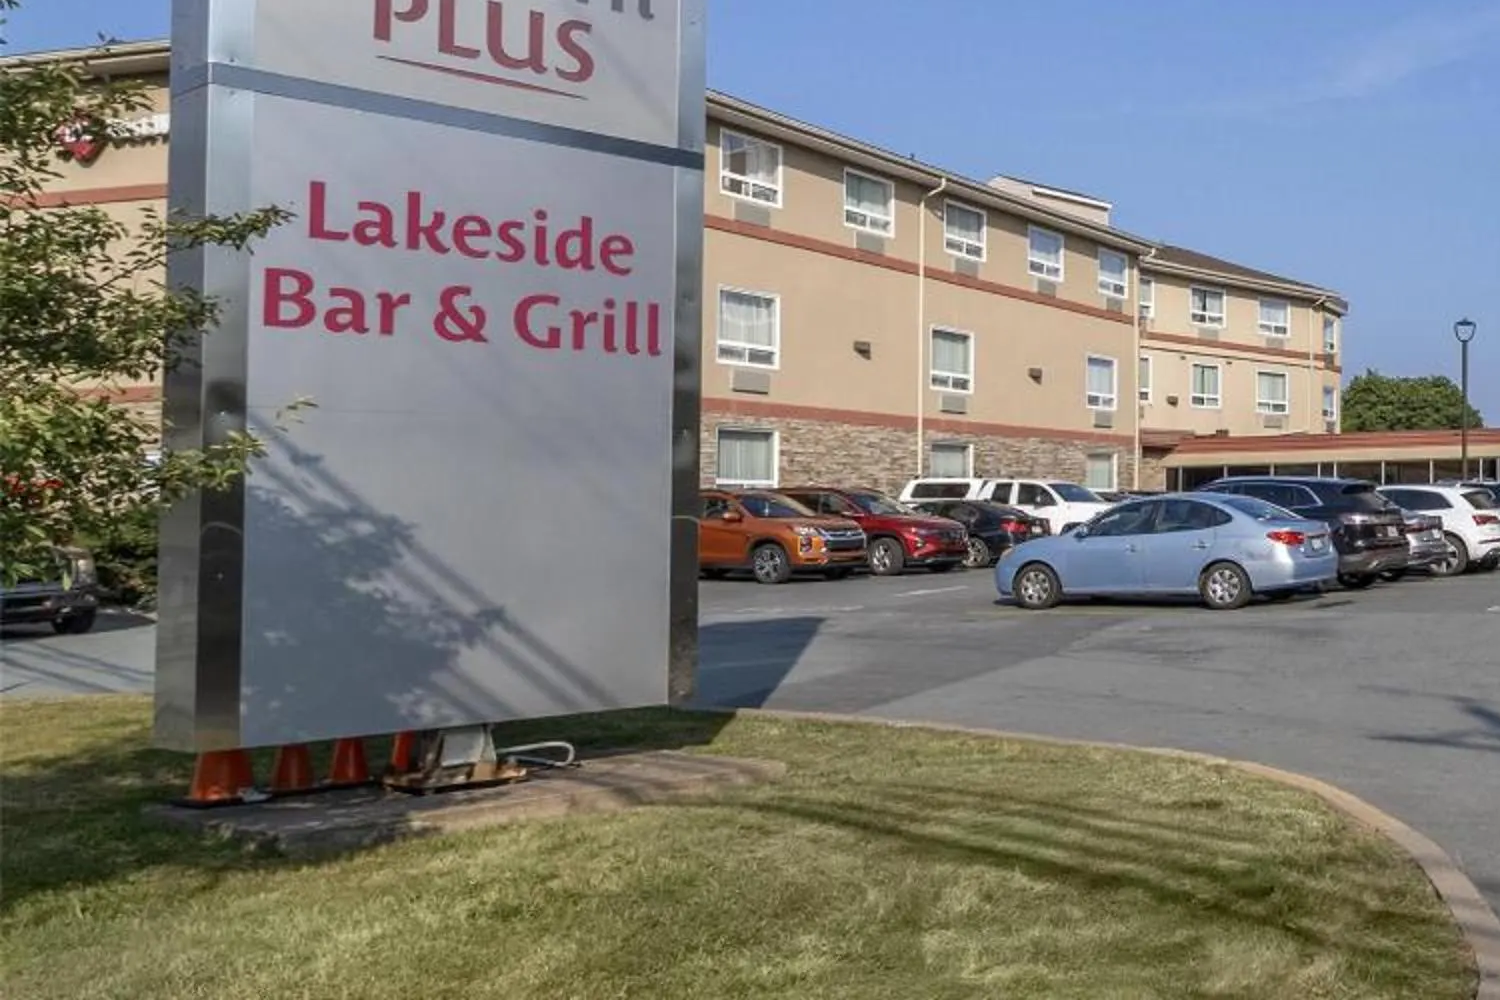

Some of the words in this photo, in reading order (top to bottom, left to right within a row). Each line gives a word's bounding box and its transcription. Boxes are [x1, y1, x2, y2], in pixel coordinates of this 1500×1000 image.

[307, 180, 635, 276] Lakeside
[262, 267, 411, 336] Bar
[433, 285, 488, 344] &
[513, 293, 662, 357] Grill
